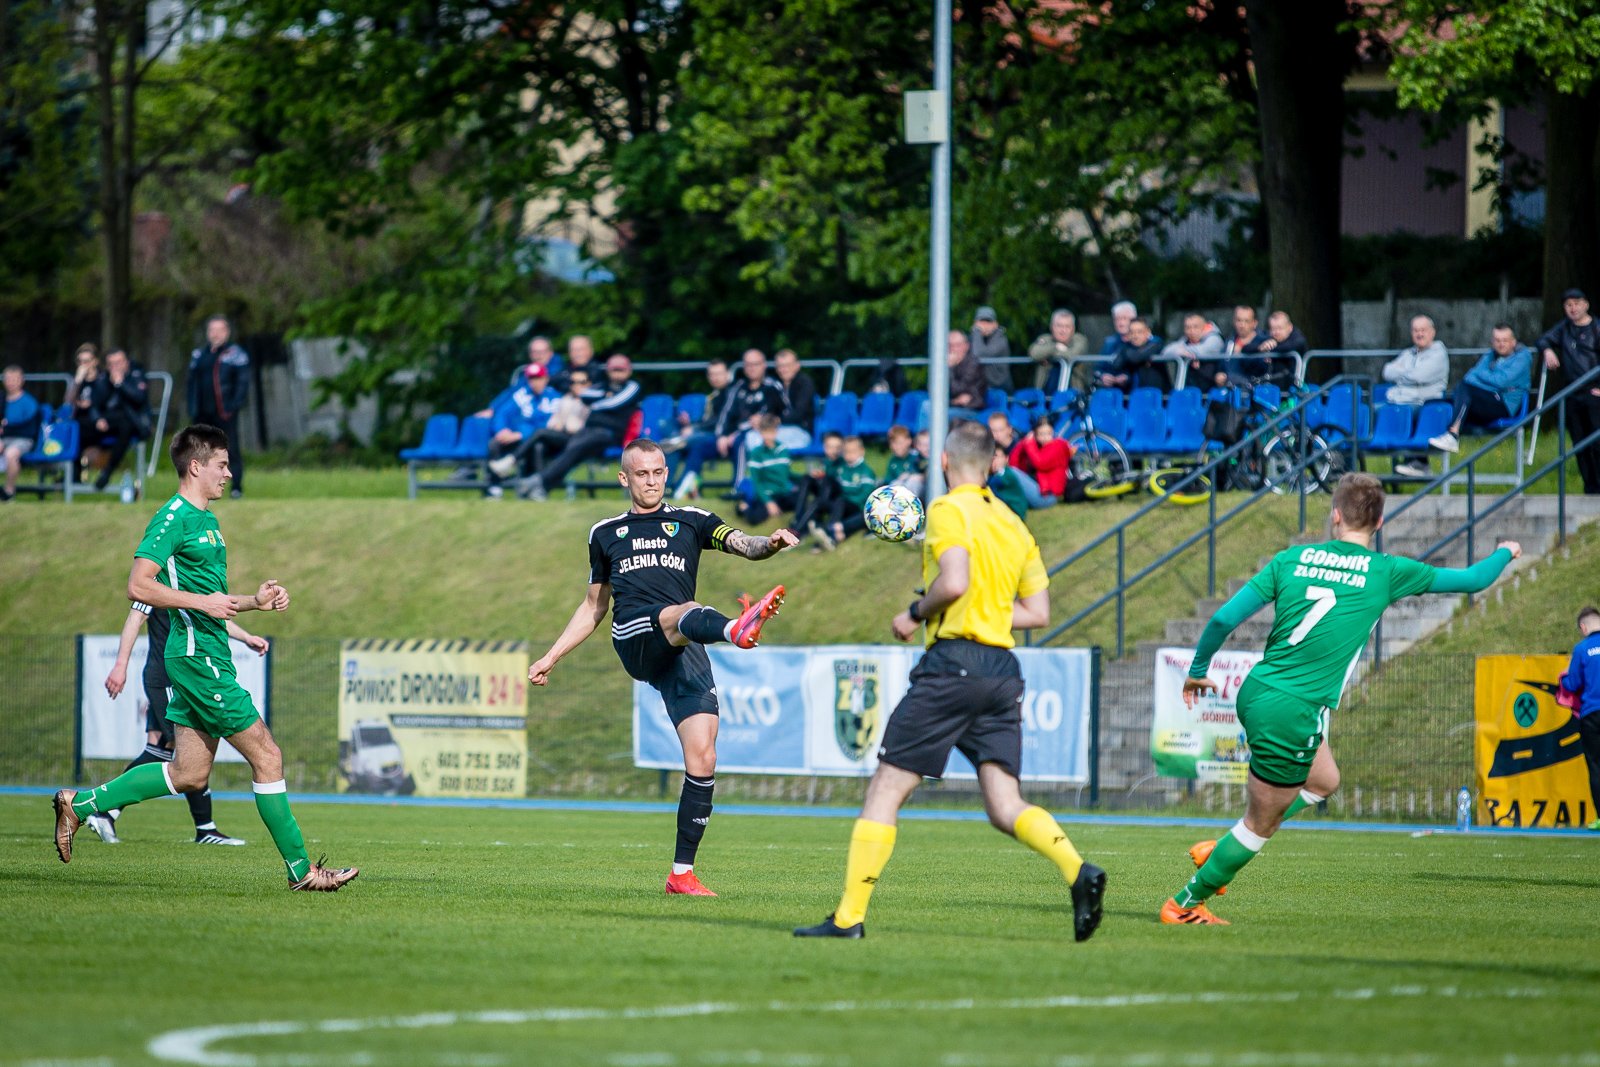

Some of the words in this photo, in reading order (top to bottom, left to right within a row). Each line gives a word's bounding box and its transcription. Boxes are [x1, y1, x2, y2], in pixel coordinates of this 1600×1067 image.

[632, 538, 668, 551] Miasto
[619, 554, 658, 574] JELENIA
[660, 552, 686, 572] GÓRA
[1287, 585, 1337, 646] 7
[346, 679, 396, 703] POMOC
[400, 673, 481, 704] DROGOWA
[486, 675, 509, 705] 24
[695, 686, 781, 726] AKO
[1022, 689, 1063, 732] KO
